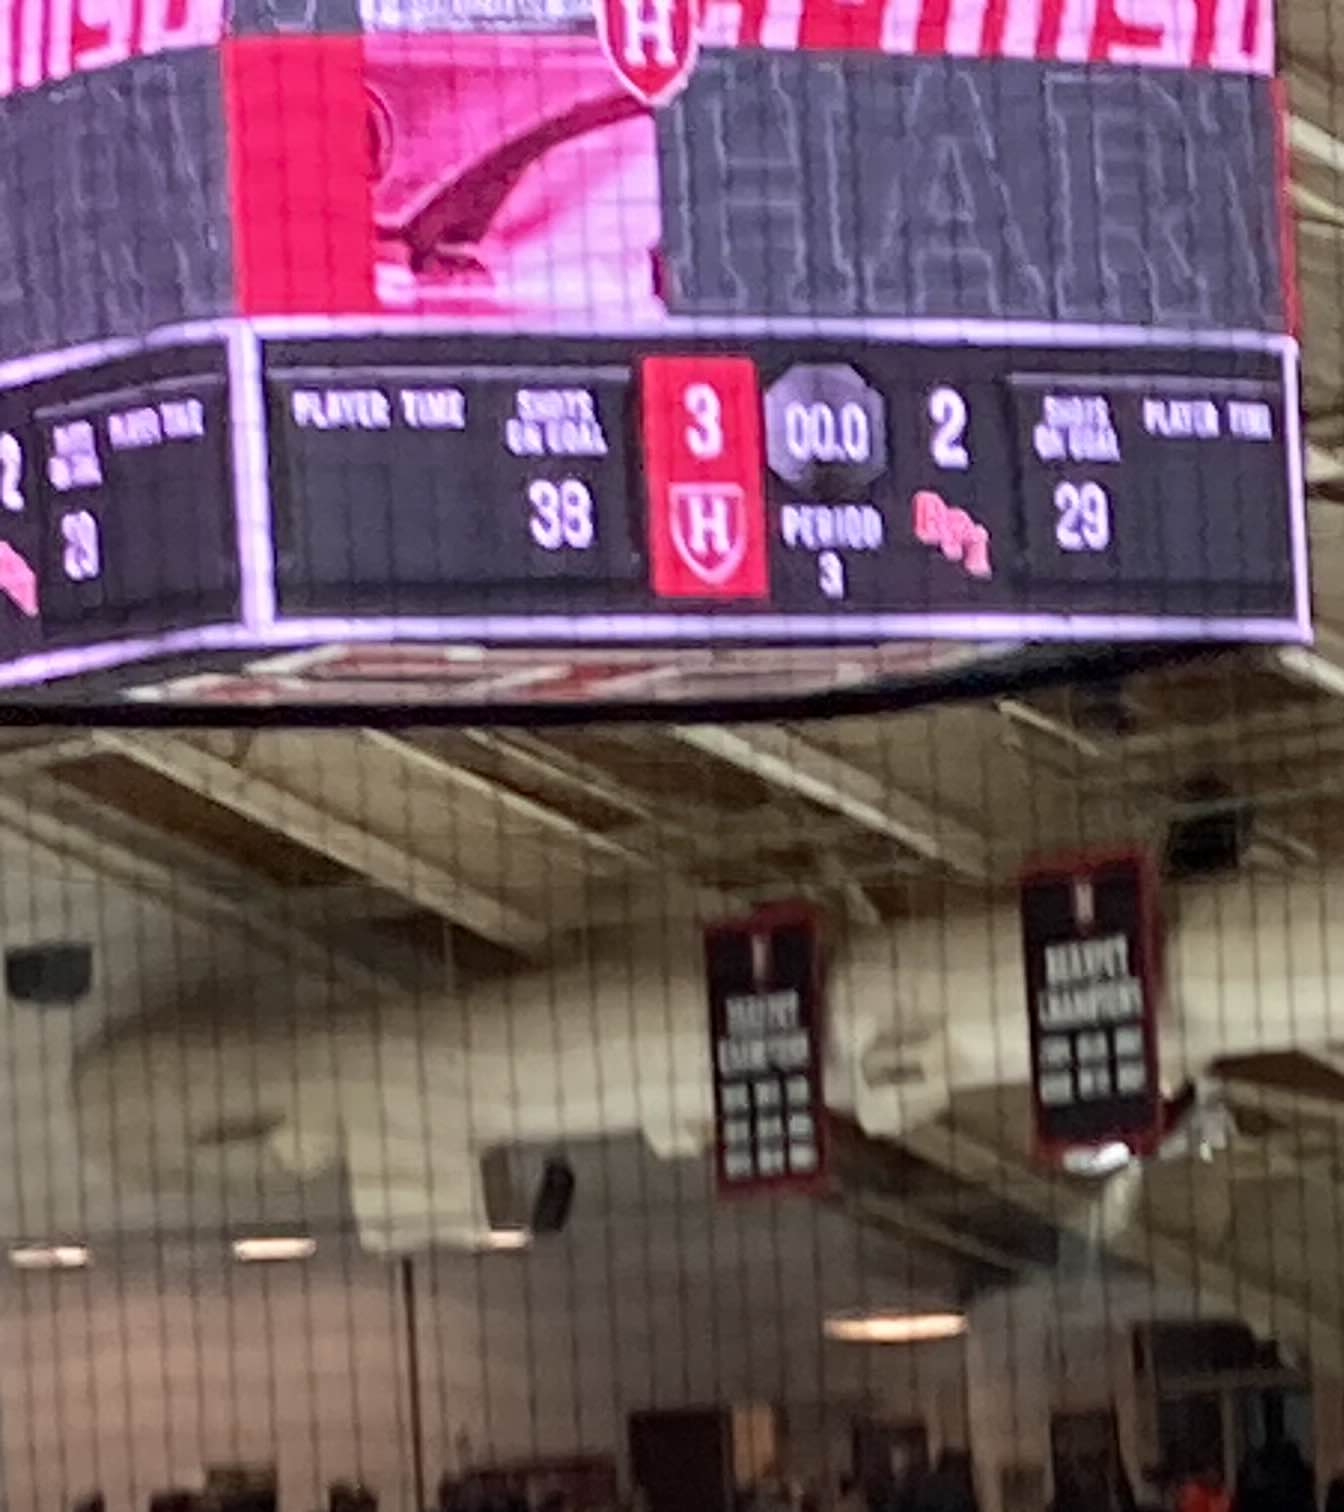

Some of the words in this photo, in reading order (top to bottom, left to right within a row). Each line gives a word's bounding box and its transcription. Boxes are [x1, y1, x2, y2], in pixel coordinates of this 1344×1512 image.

[683, 382, 724, 461] 3
[928, 387, 970, 470] 2
[781, 503, 884, 550] PERIOD
[1054, 481, 1110, 551] 29
